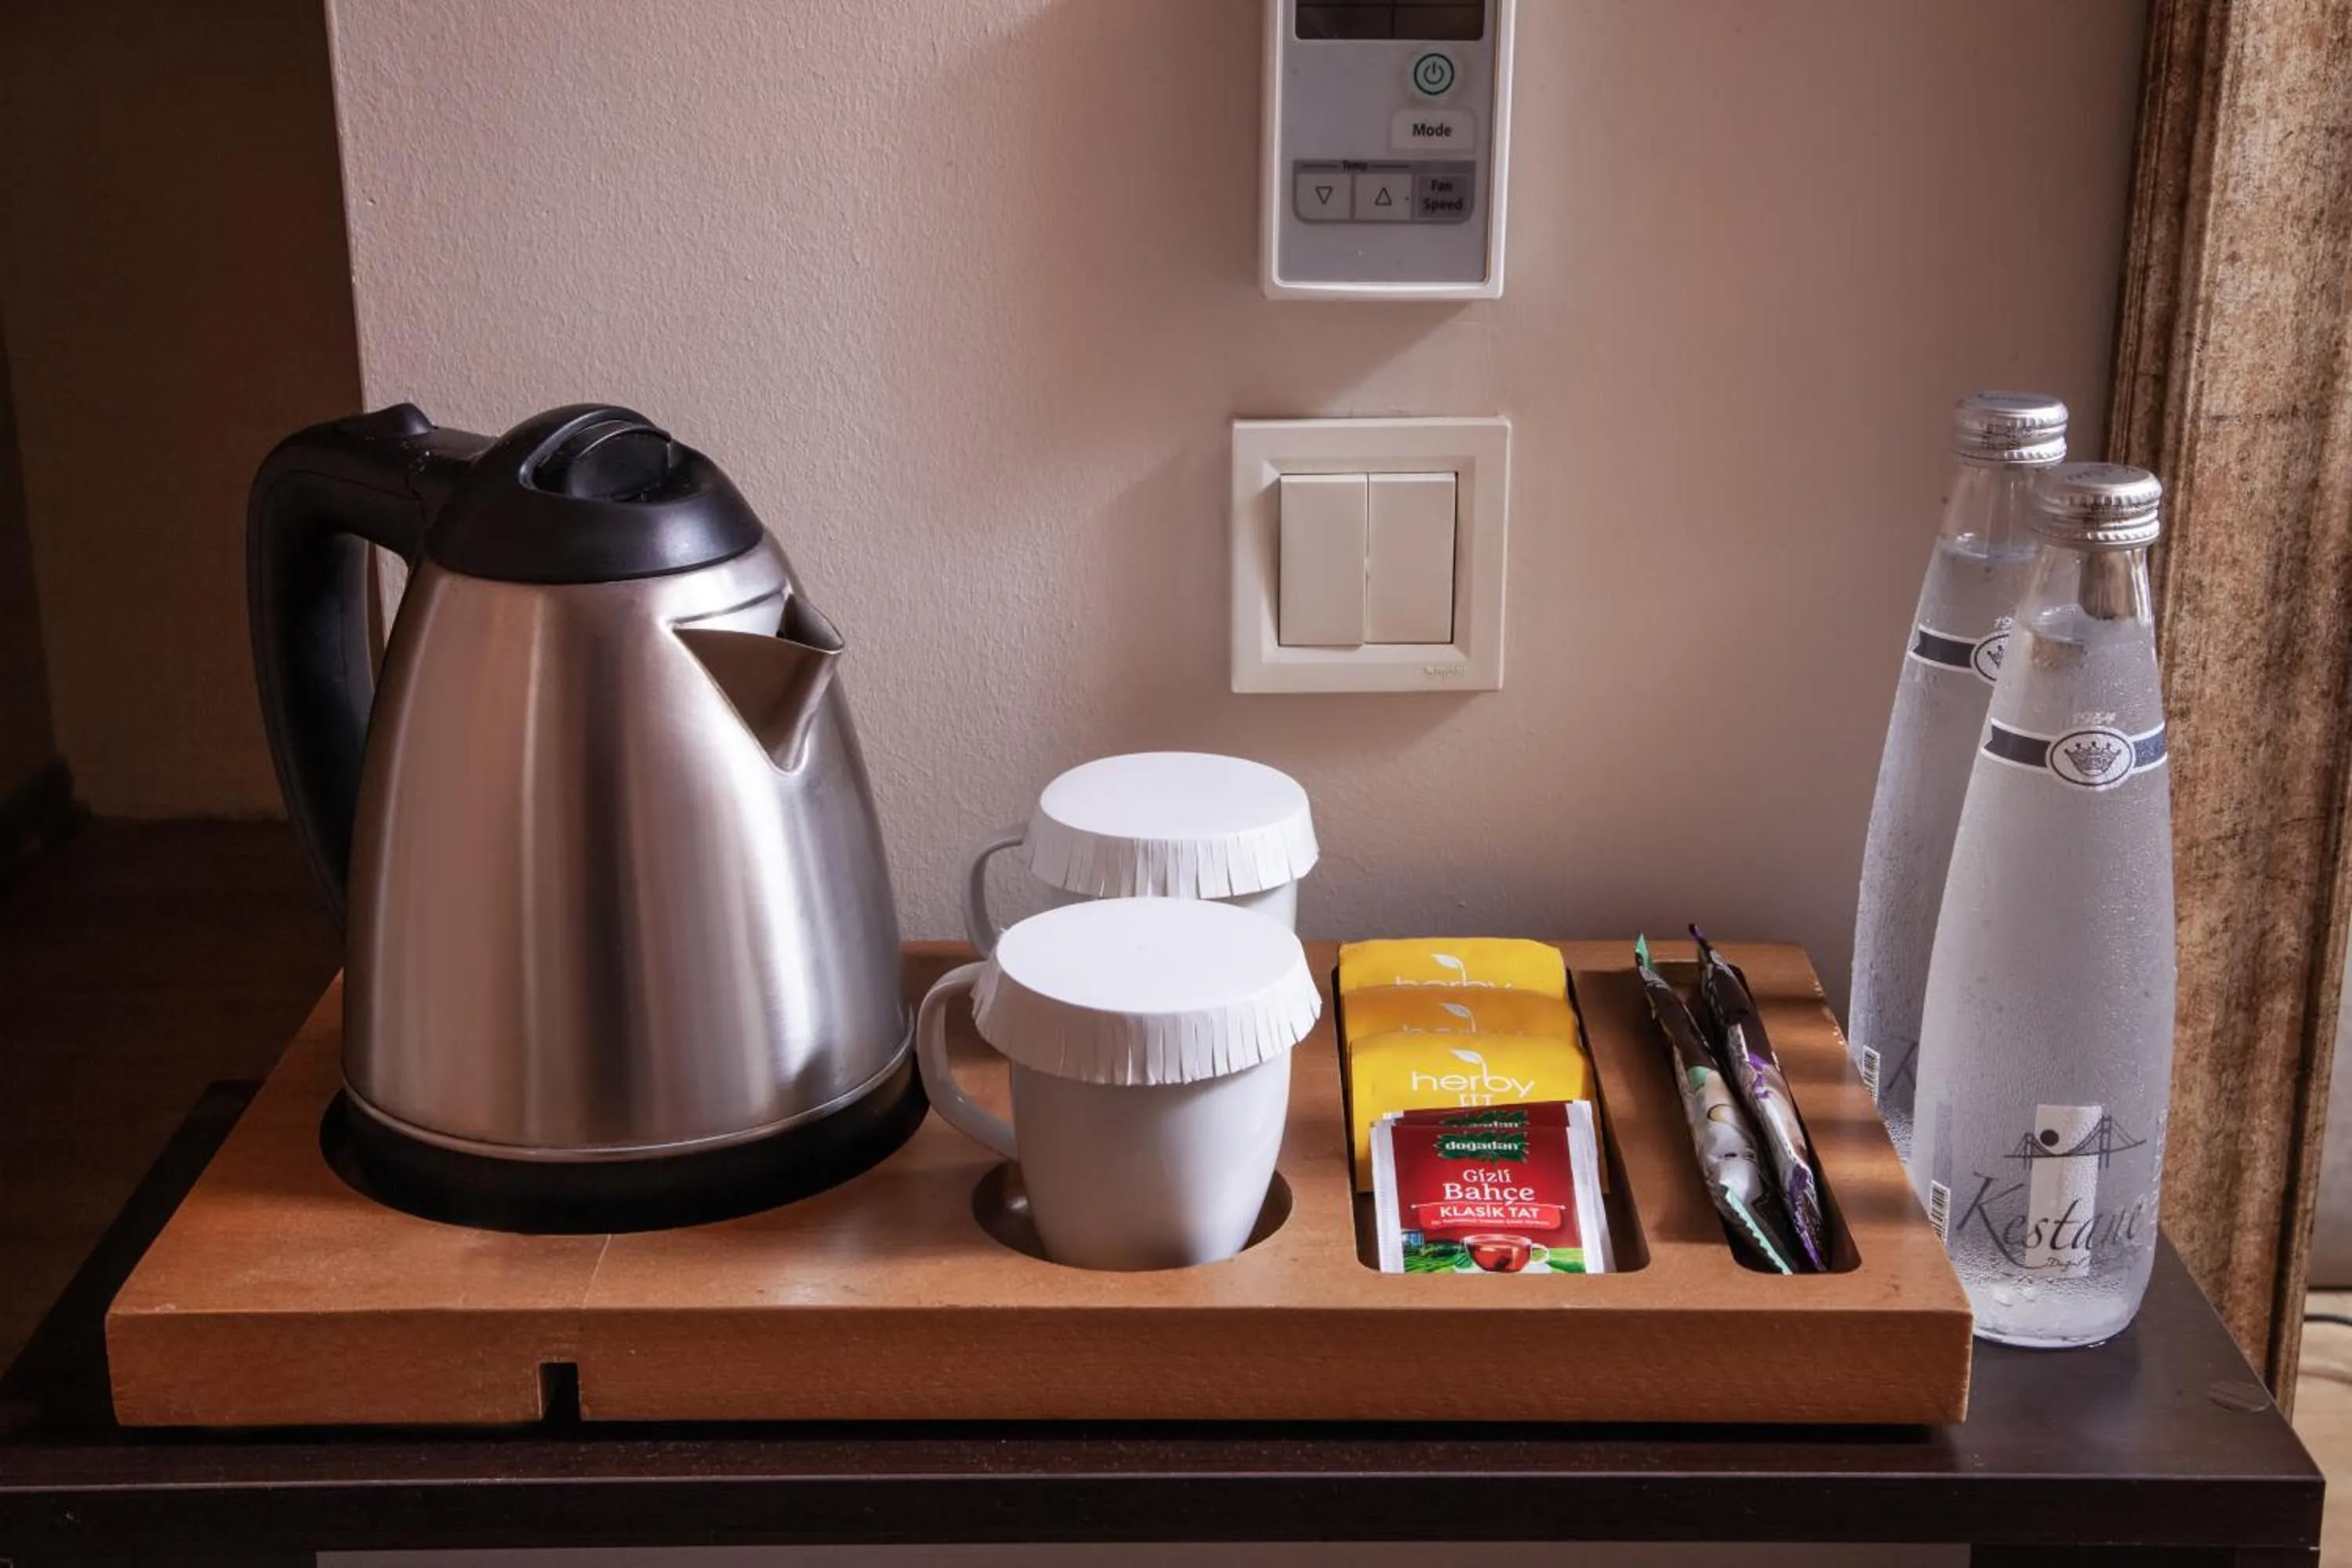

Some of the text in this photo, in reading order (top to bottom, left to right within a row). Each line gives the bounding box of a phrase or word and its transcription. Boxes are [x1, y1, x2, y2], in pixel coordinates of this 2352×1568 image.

[1412, 124, 1451, 137] Mode
[1342, 160, 1368, 172] Temp
[1431, 180, 1452, 191] Fan
[1423, 198, 1463, 211] Speed
[1411, 1069, 1535, 1098] herby
[1462, 1168, 1512, 1183] Gizli
[1443, 1182, 1535, 1206] Bahçe
[1508, 1206, 1540, 1218] TAT
